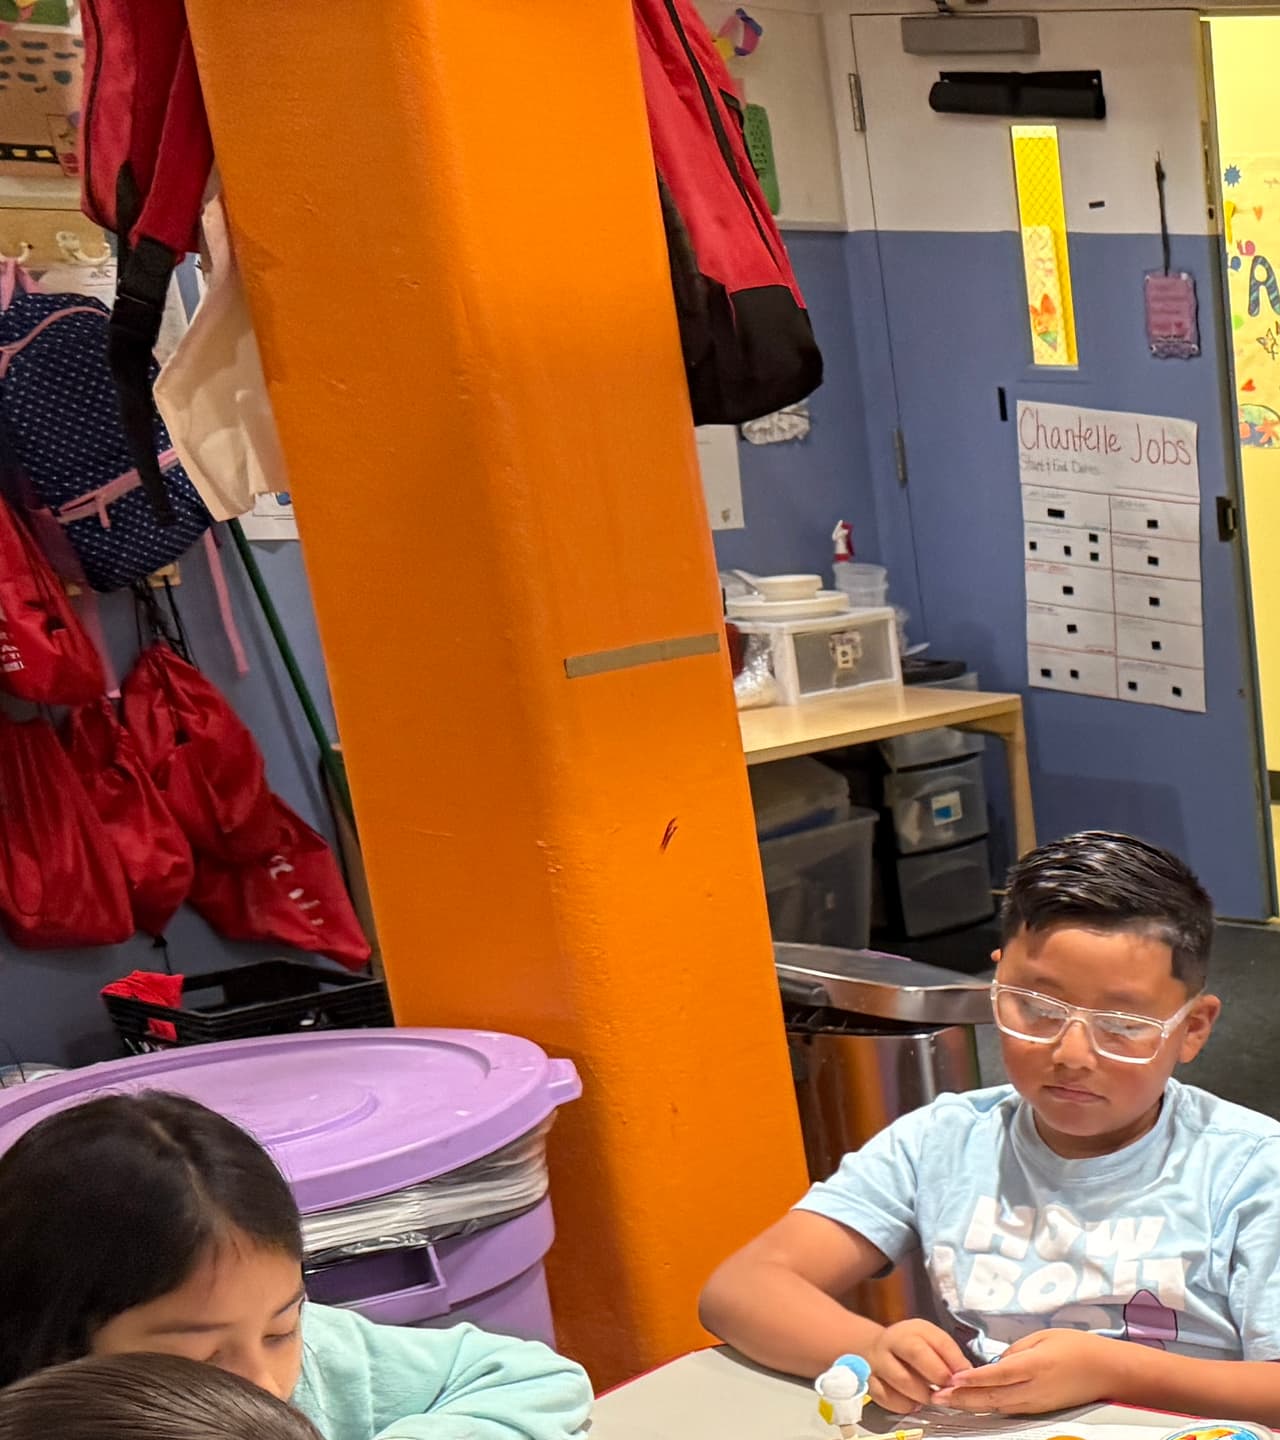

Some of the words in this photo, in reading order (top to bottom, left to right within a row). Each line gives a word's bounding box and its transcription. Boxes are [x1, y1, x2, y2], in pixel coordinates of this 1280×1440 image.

[1019, 407, 1121, 454] Chantelle
[1130, 423, 1192, 466] Jobs
[963, 1194, 1166, 1262] HOW
